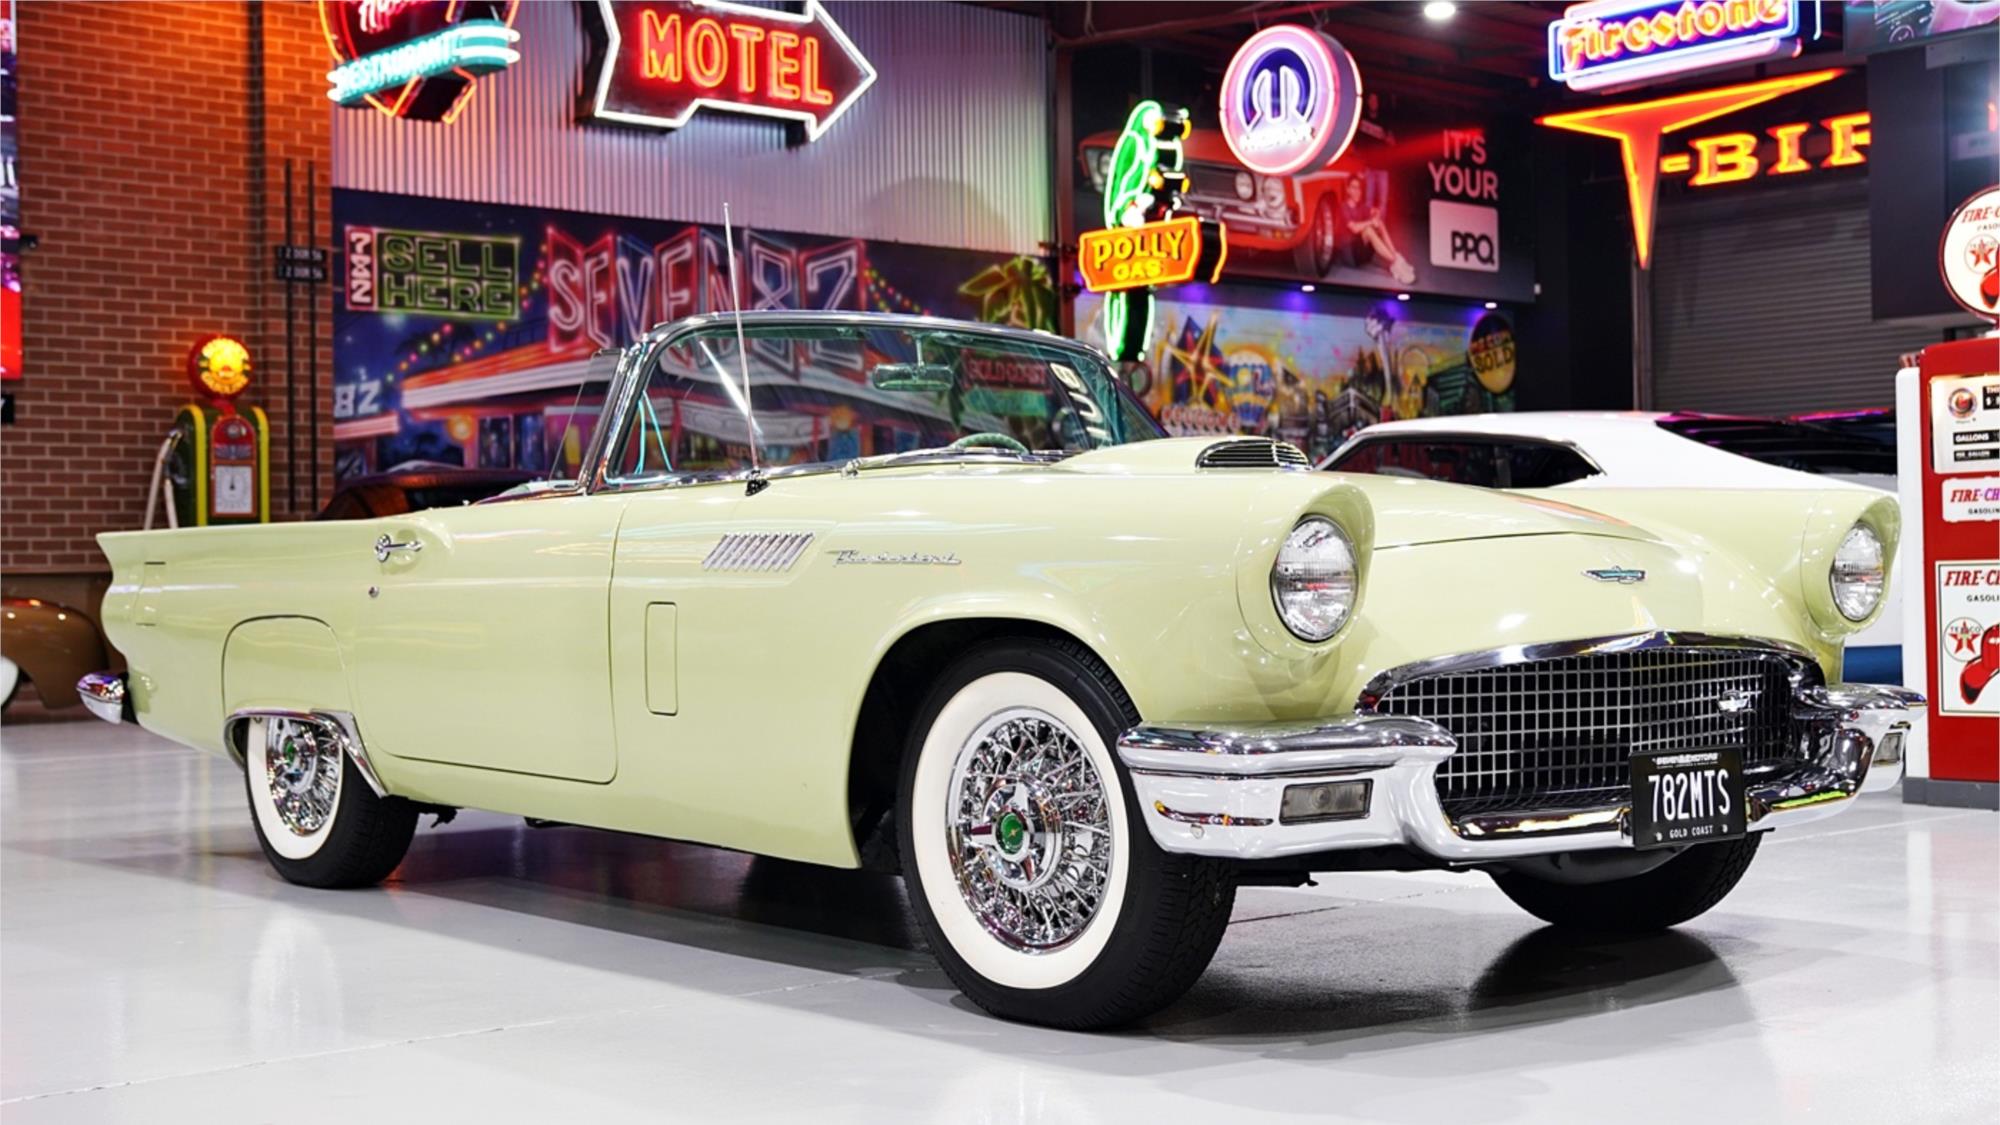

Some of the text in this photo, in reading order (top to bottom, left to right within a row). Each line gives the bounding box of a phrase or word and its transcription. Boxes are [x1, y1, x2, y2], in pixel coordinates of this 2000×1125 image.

[1563, 0, 1787, 70] Firestone
[641, 10, 834, 105] MOTEL
[1443, 129, 1487, 165] IT'S
[1428, 161, 1499, 200] YOUR
[383, 235, 513, 280] SELL
[1092, 228, 1186, 271] POLLY
[1451, 229, 1496, 267] PPQ
[1112, 258, 1162, 282] GAS
[383, 272, 513, 314] HERE
[1475, 345, 1514, 374] SOLD
[1955, 432, 1990, 442] GALLONS
[1966, 594, 2000, 602] GASOLI
[1950, 625, 1981, 635] TEXACO
[1648, 769, 1730, 823] 782MTS
[1669, 825, 1714, 839] GOLD COAST
